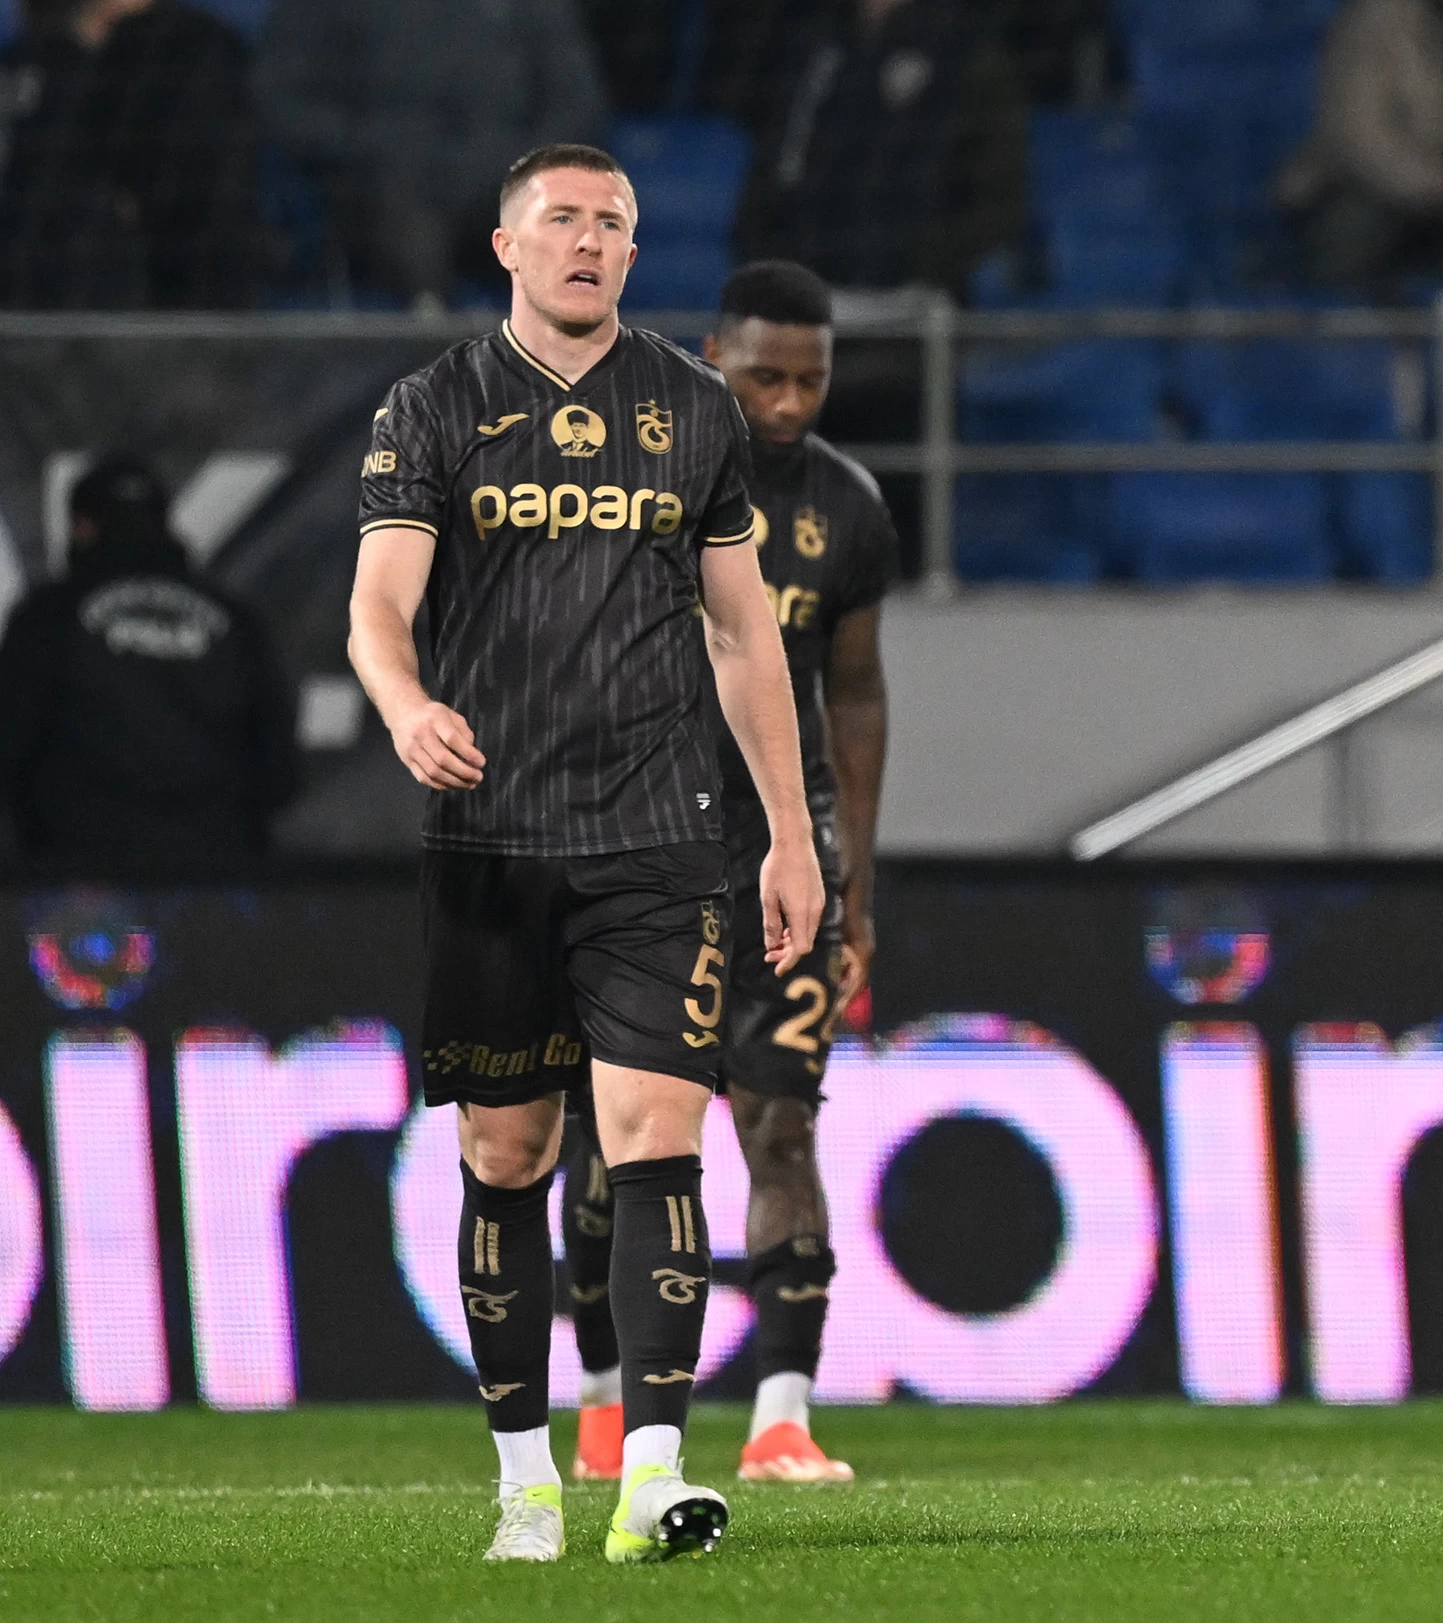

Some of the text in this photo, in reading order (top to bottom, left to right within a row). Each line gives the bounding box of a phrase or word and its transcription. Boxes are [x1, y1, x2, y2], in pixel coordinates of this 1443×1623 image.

[471, 483, 683, 541] papara
[684, 945, 725, 1029] 5
[469, 1032, 582, 1078] Rent Go
